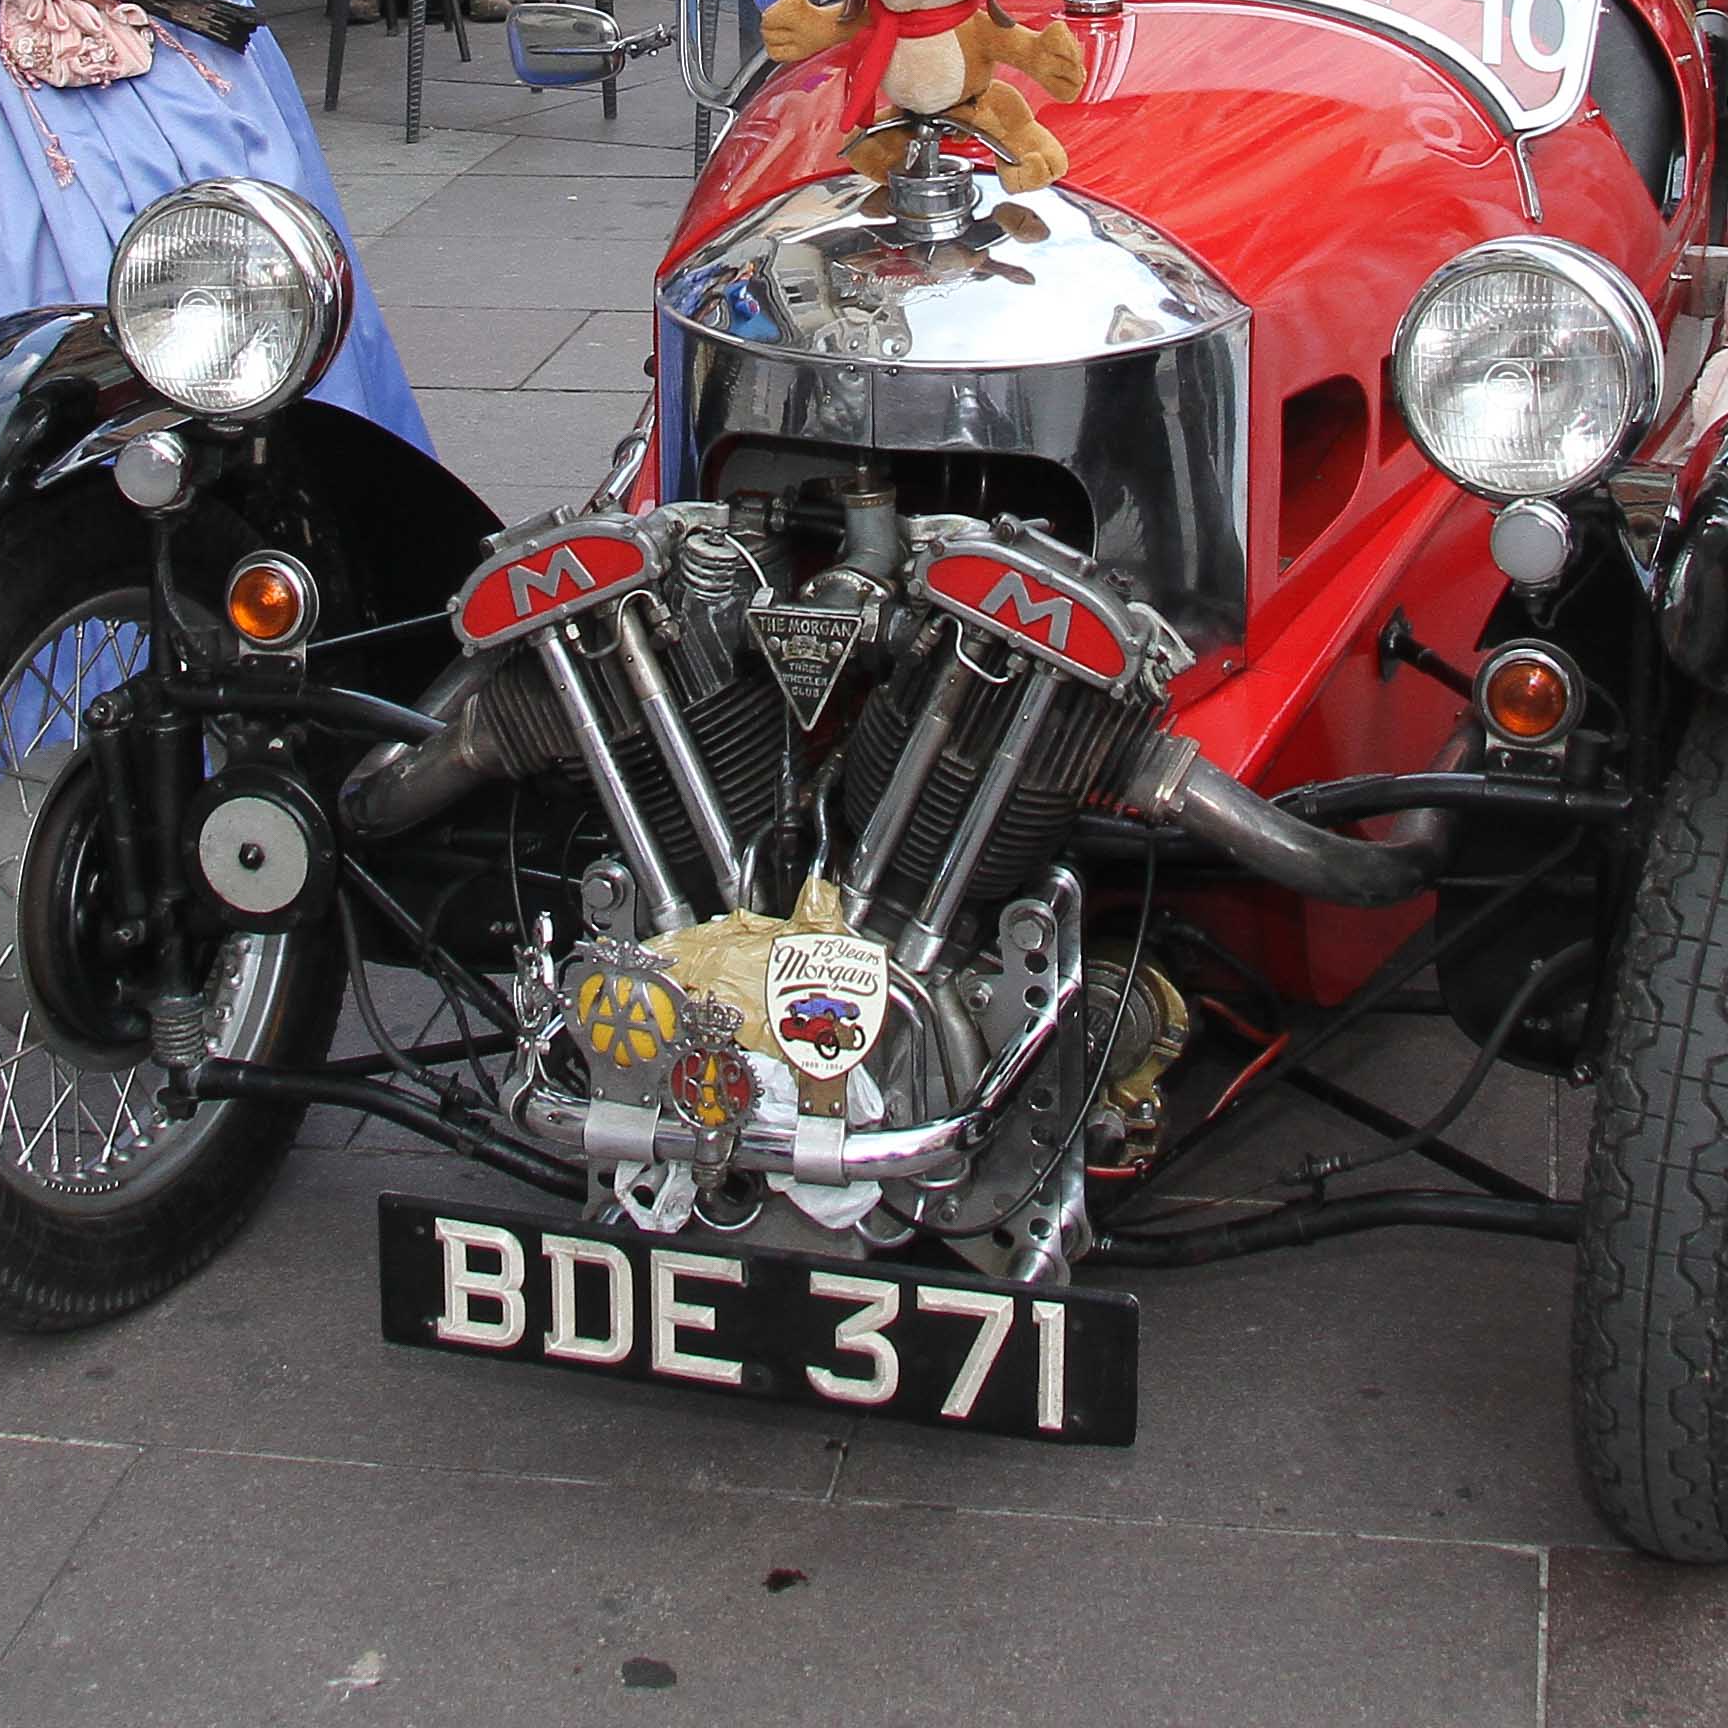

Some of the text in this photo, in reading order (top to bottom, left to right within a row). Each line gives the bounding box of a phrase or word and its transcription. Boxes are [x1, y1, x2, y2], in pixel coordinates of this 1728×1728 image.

[507, 544, 597, 618] M
[978, 568, 1072, 651] M
[758, 615, 853, 637] THE MORGAN
[782, 673, 828, 687] WHEELER
[789, 662, 823, 674] THREE
[792, 685, 820, 698] CLUB
[812, 938, 881, 965] 75 Years
[774, 945, 880, 992] Morgans
[435, 1216, 1066, 1431] BDE 371
